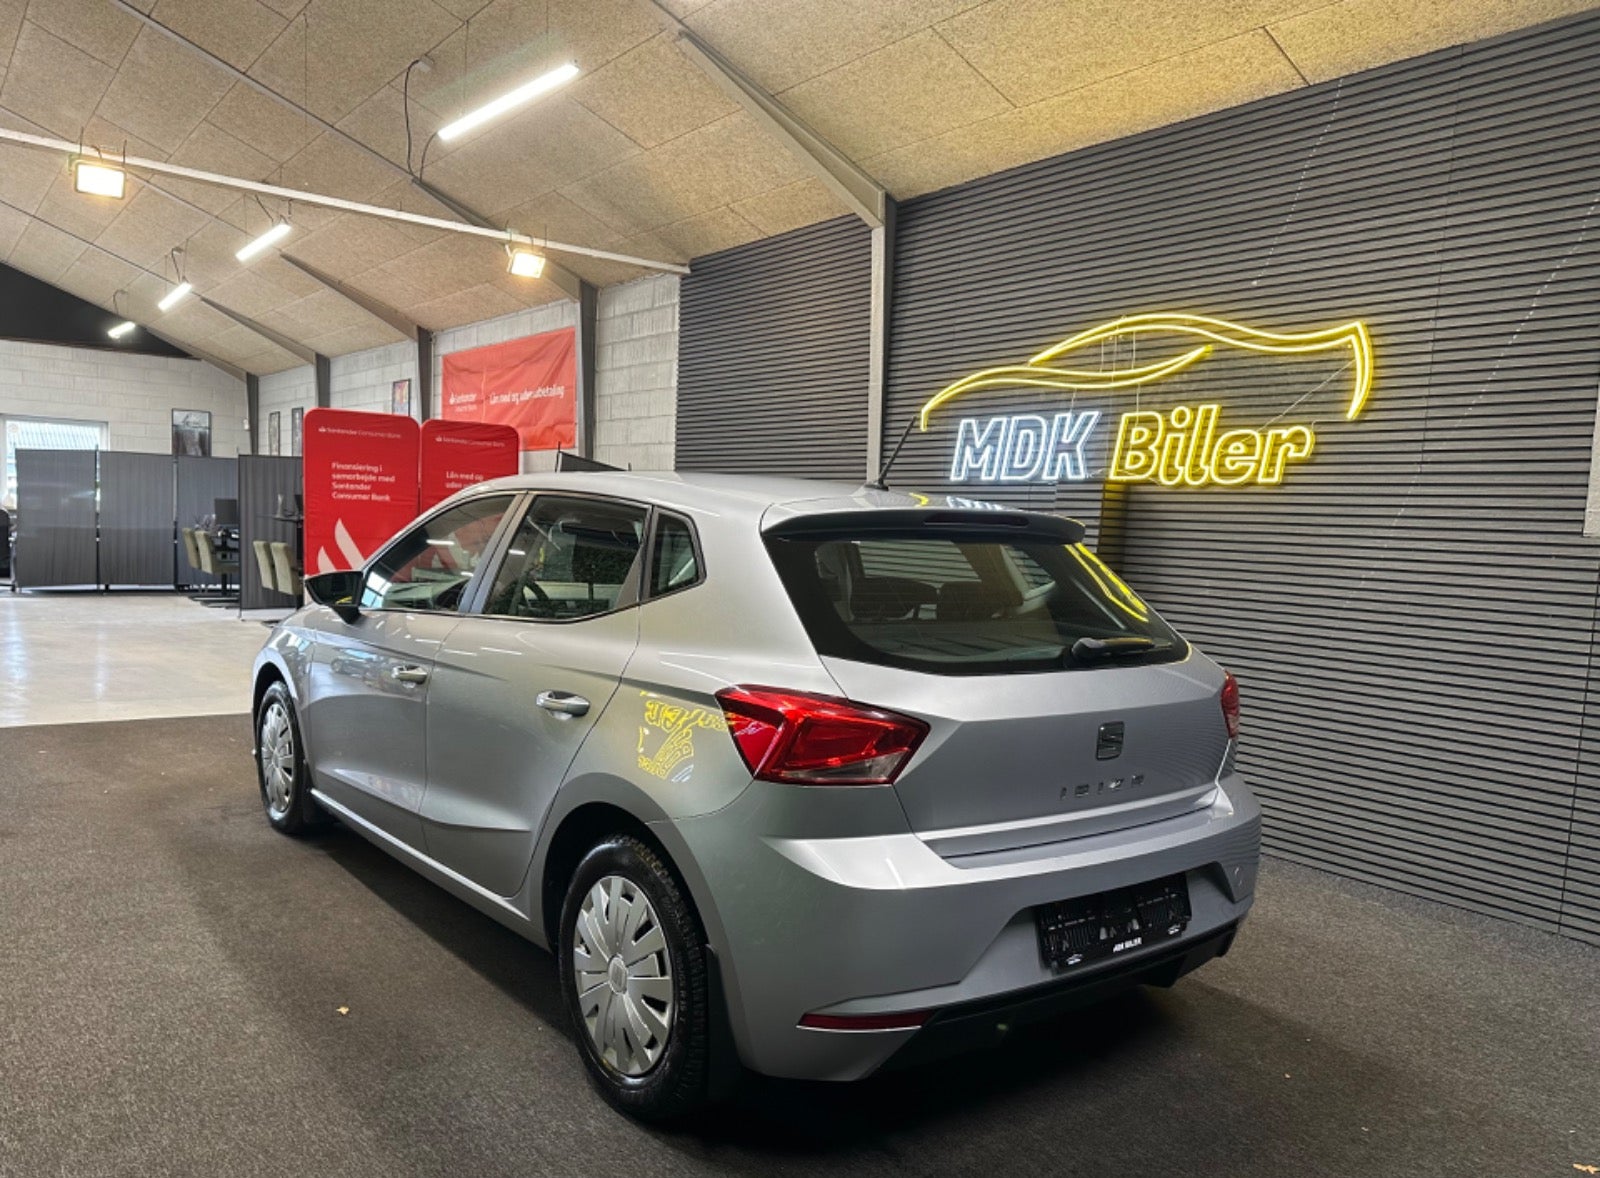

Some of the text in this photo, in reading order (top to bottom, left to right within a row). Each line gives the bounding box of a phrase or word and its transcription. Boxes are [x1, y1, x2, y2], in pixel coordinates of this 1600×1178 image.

[951, 404, 1314, 486] MDK Biler
[331, 462, 379, 474] Finansiering
[331, 473, 396, 483] samarbejde med
[446, 471, 459, 480] Lån
[460, 472, 474, 481] med
[331, 481, 371, 491] Santander
[331, 491, 391, 502] Consumer Bank
